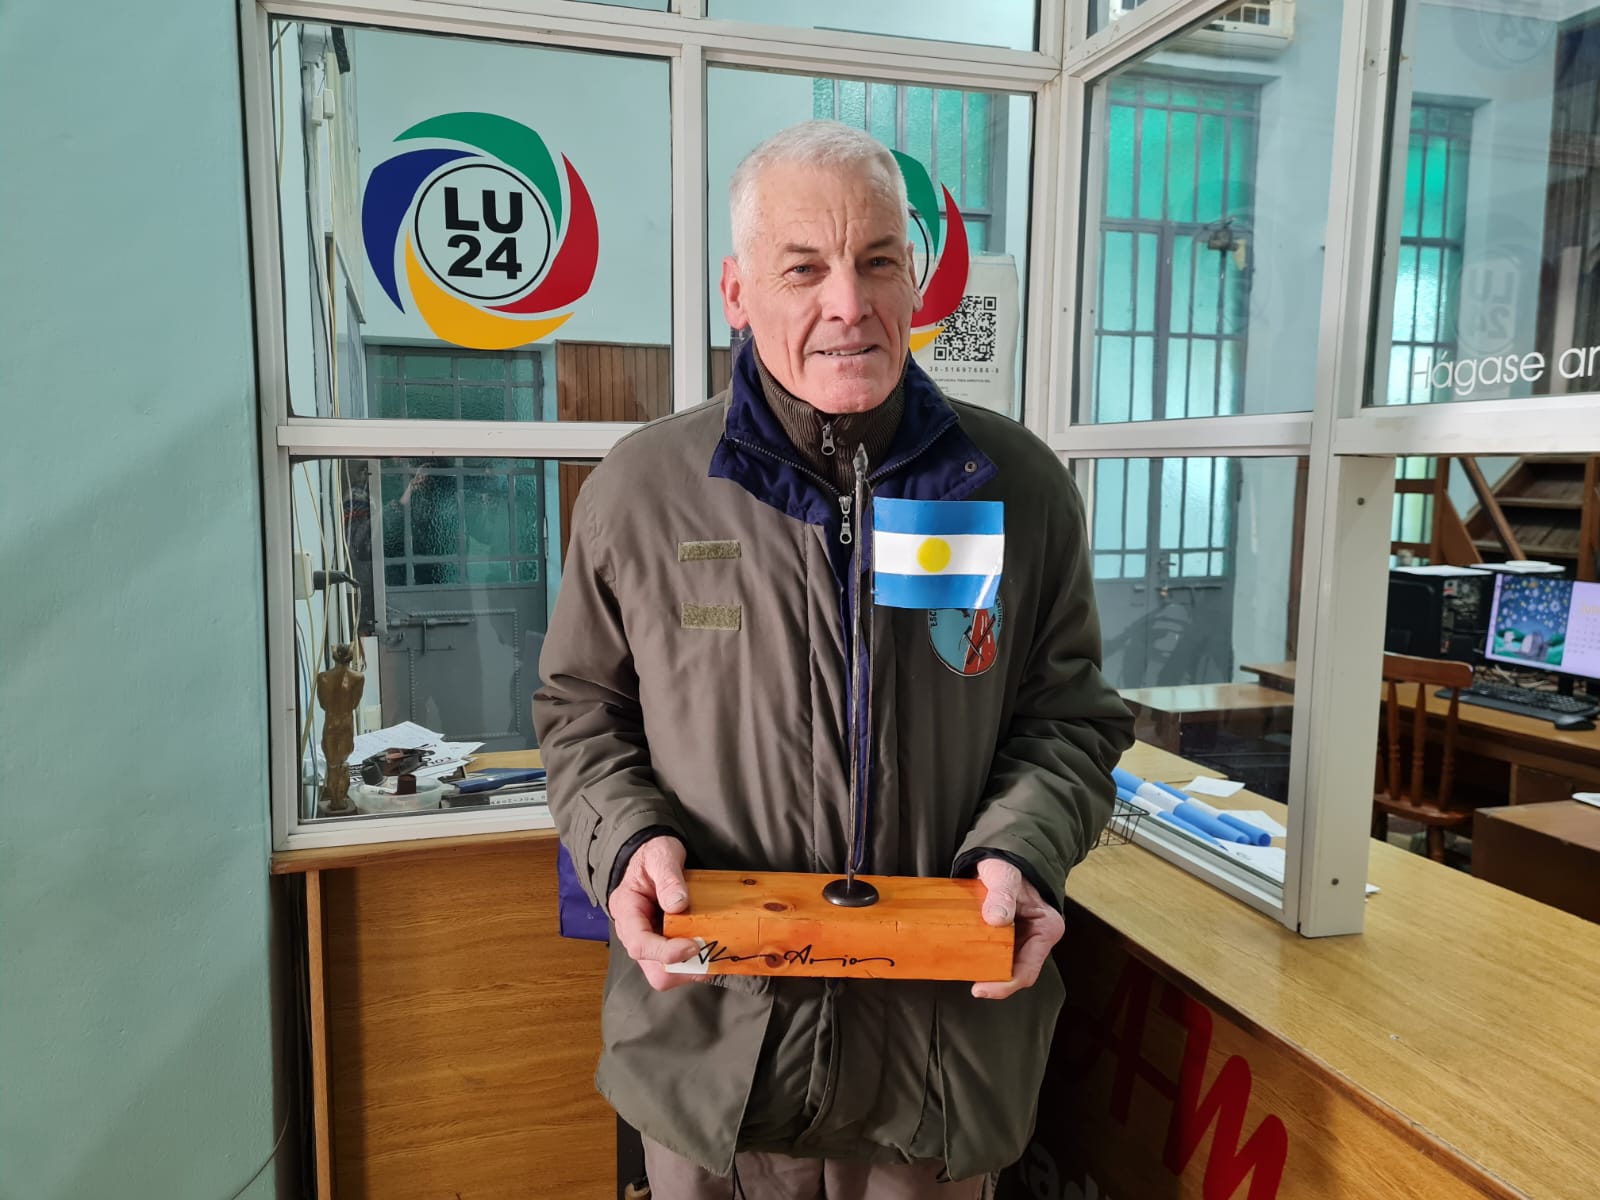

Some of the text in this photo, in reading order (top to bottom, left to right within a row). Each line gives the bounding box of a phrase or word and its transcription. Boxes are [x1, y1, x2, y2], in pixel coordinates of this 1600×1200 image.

[443, 186, 524, 235] LU
[446, 233, 523, 280] 24
[1413, 351, 1545, 395] Hágase
